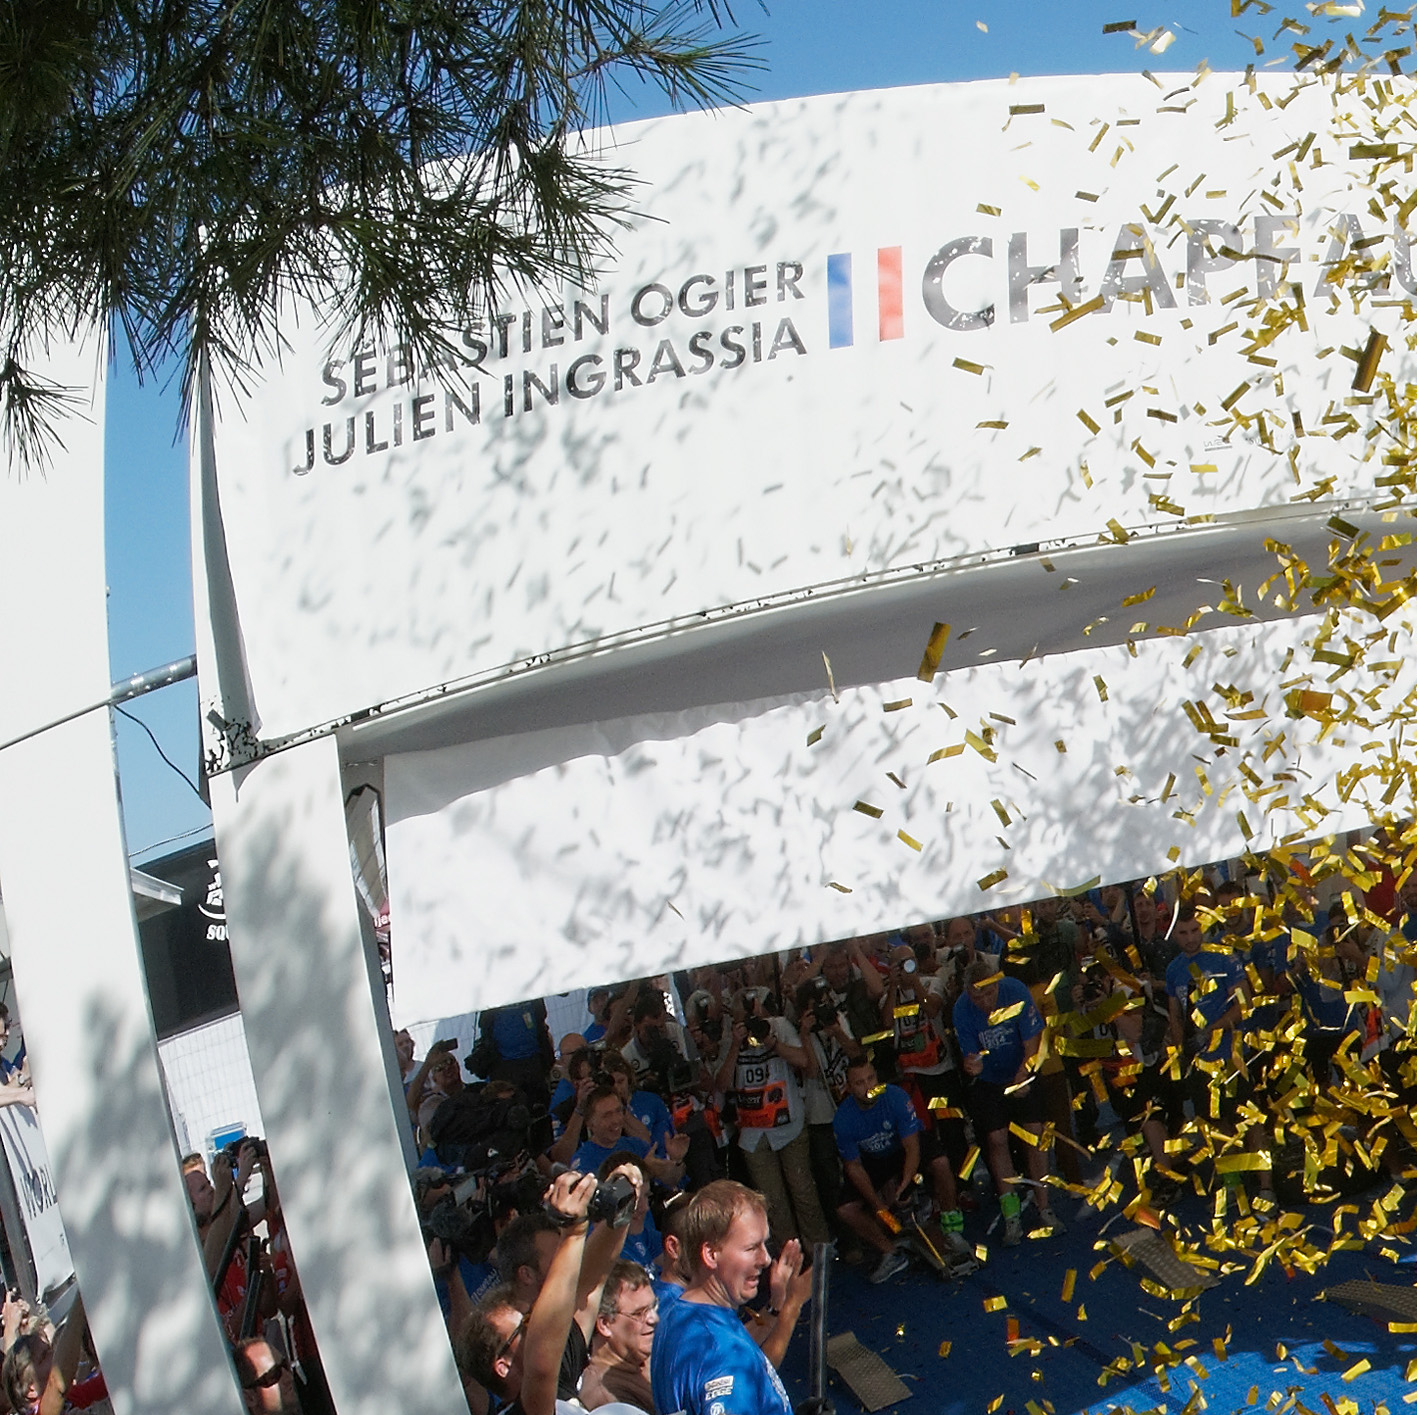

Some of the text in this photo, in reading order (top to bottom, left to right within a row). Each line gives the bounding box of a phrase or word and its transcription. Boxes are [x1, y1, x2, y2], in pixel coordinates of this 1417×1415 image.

[631, 260, 805, 328] OGIER
[293, 316, 808, 477] JULIEN INGRASSIA
